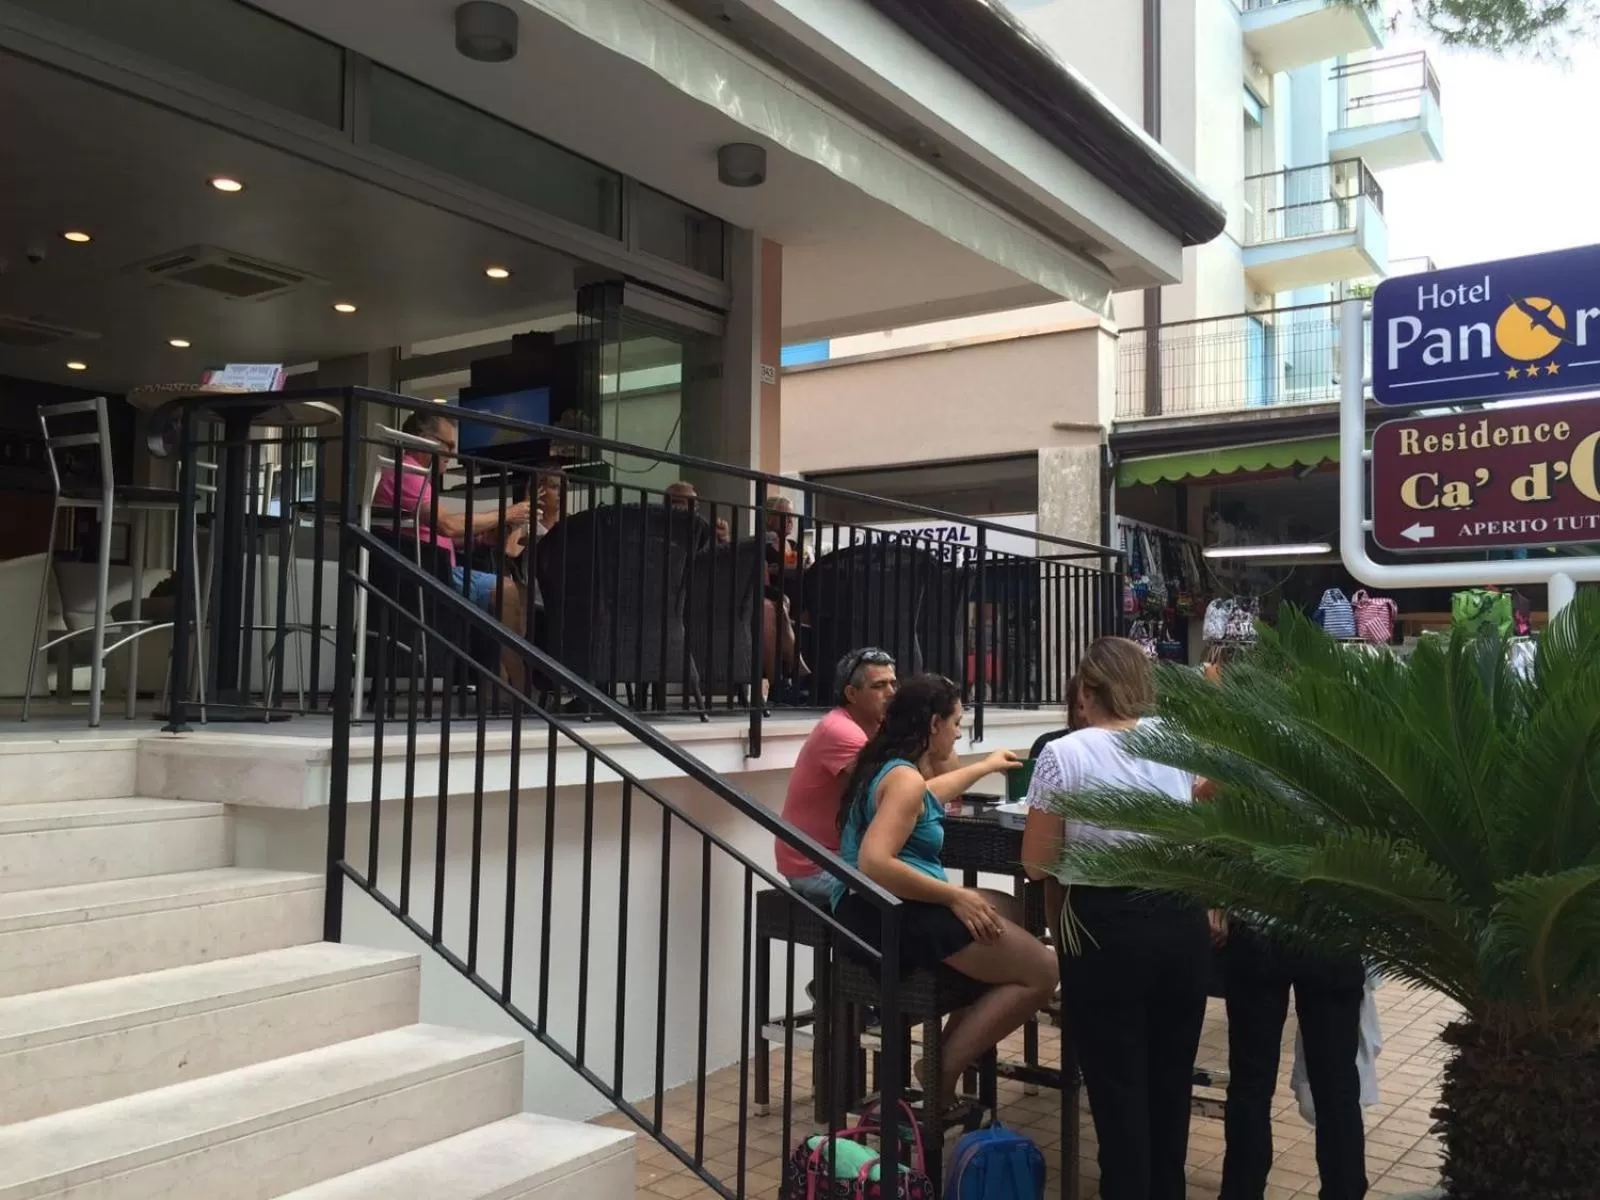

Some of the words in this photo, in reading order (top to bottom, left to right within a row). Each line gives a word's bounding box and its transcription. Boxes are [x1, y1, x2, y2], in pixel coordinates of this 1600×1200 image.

[1418, 275, 1490, 311] Hotel
[1399, 419, 1570, 455] Residence
[1401, 467, 1489, 510] Ca'
[1458, 518, 1548, 537] APERTO
